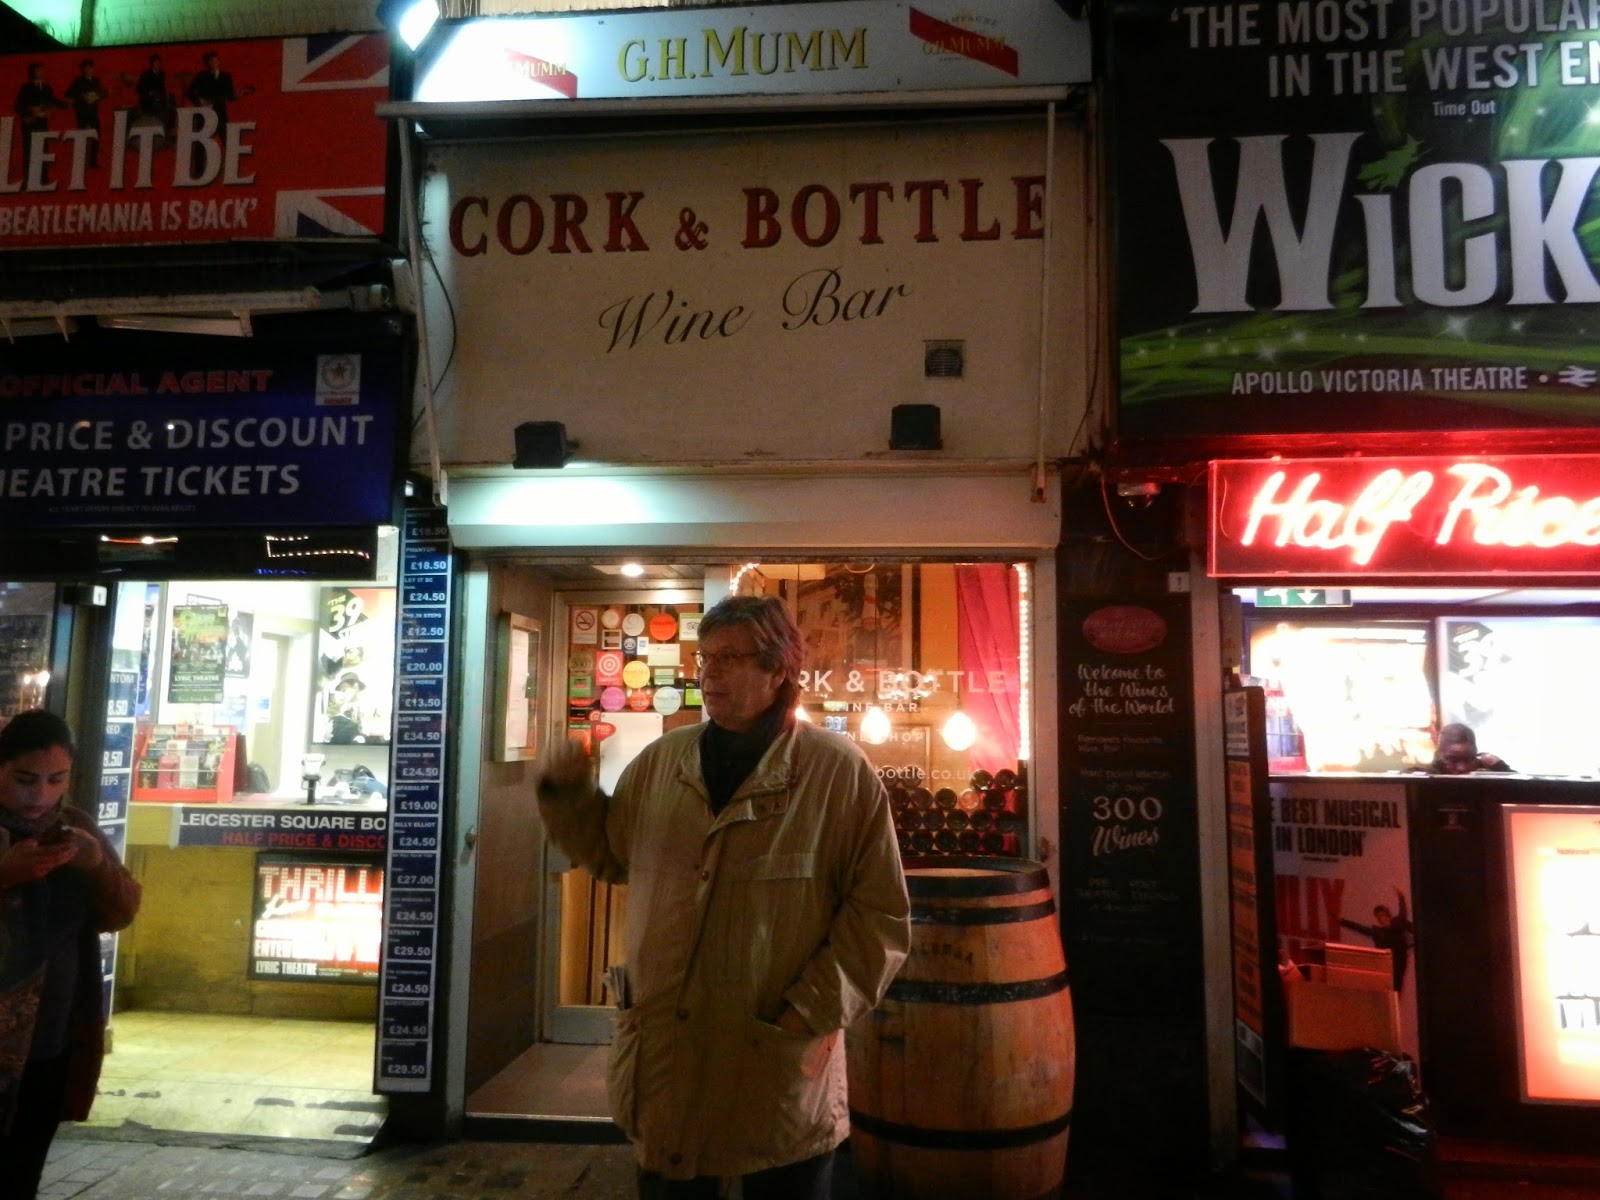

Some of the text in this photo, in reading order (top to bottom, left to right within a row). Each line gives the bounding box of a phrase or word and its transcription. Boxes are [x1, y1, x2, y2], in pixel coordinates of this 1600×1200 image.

[1279, 0, 1392, 44] MOST
[1269, 53, 1310, 98] IN
[1326, 50, 1407, 95] THE
[1423, 43, 1543, 91] WEST
[1433, 100, 1496, 117] Time Out
[0, 106, 256, 194] LET IT BE
[0, 203, 154, 236] BEATLEMANIA
[161, 201, 182, 231] IS
[449, 175, 1046, 257] CORK & BOTTLE
[599, 266, 914, 354] Wine Bar
[0, 369, 274, 397] OFFICIAL AGENT
[1232, 366, 1528, 395] APOLLO VICTORIA THEATRE
[5, 414, 374, 452] PRICE & DISCOUNT
[141, 463, 300, 497] TICKETS
[1240, 469, 1434, 566] Half
[411, 561, 447, 570] £18.50
[409, 592, 446, 602] £24.50
[329, 597, 363, 632] 39
[407, 627, 444, 636] £12.50
[406, 662, 442, 672] £20.00
[1078, 664, 1166, 681] Welcome to
[845, 670, 865, 693] &
[879, 670, 1006, 693] BOTTLE
[1084, 681, 1169, 698] the Wines
[405, 698, 441, 708] £13.50
[883, 702, 918, 712] BAR
[1069, 697, 1174, 718] of the World
[403, 731, 440, 741] £34.50
[402, 767, 439, 777] £24.50
[400, 801, 438, 811] £19.00
[1092, 796, 1163, 821] 300
[1281, 797, 1401, 829] BEST MUSICAL
[179, 813, 275, 828] LEICESTER
[281, 815, 355, 831] SQUARE
[223, 832, 264, 846] HALF
[269, 833, 317, 848] PRICE
[322, 834, 332, 848] &
[399, 837, 436, 847] £24.50
[1091, 824, 1160, 857] Wines
[1276, 826, 1292, 853] IN
[259, 866, 384, 903] THRILL
[396, 875, 434, 885] £27.00
[396, 911, 433, 921] £24.50
[393, 945, 431, 956] £29.50
[255, 960, 279, 974] LYRIC
[281, 961, 318, 976] THEATRE
[391, 984, 429, 994] £24.50
